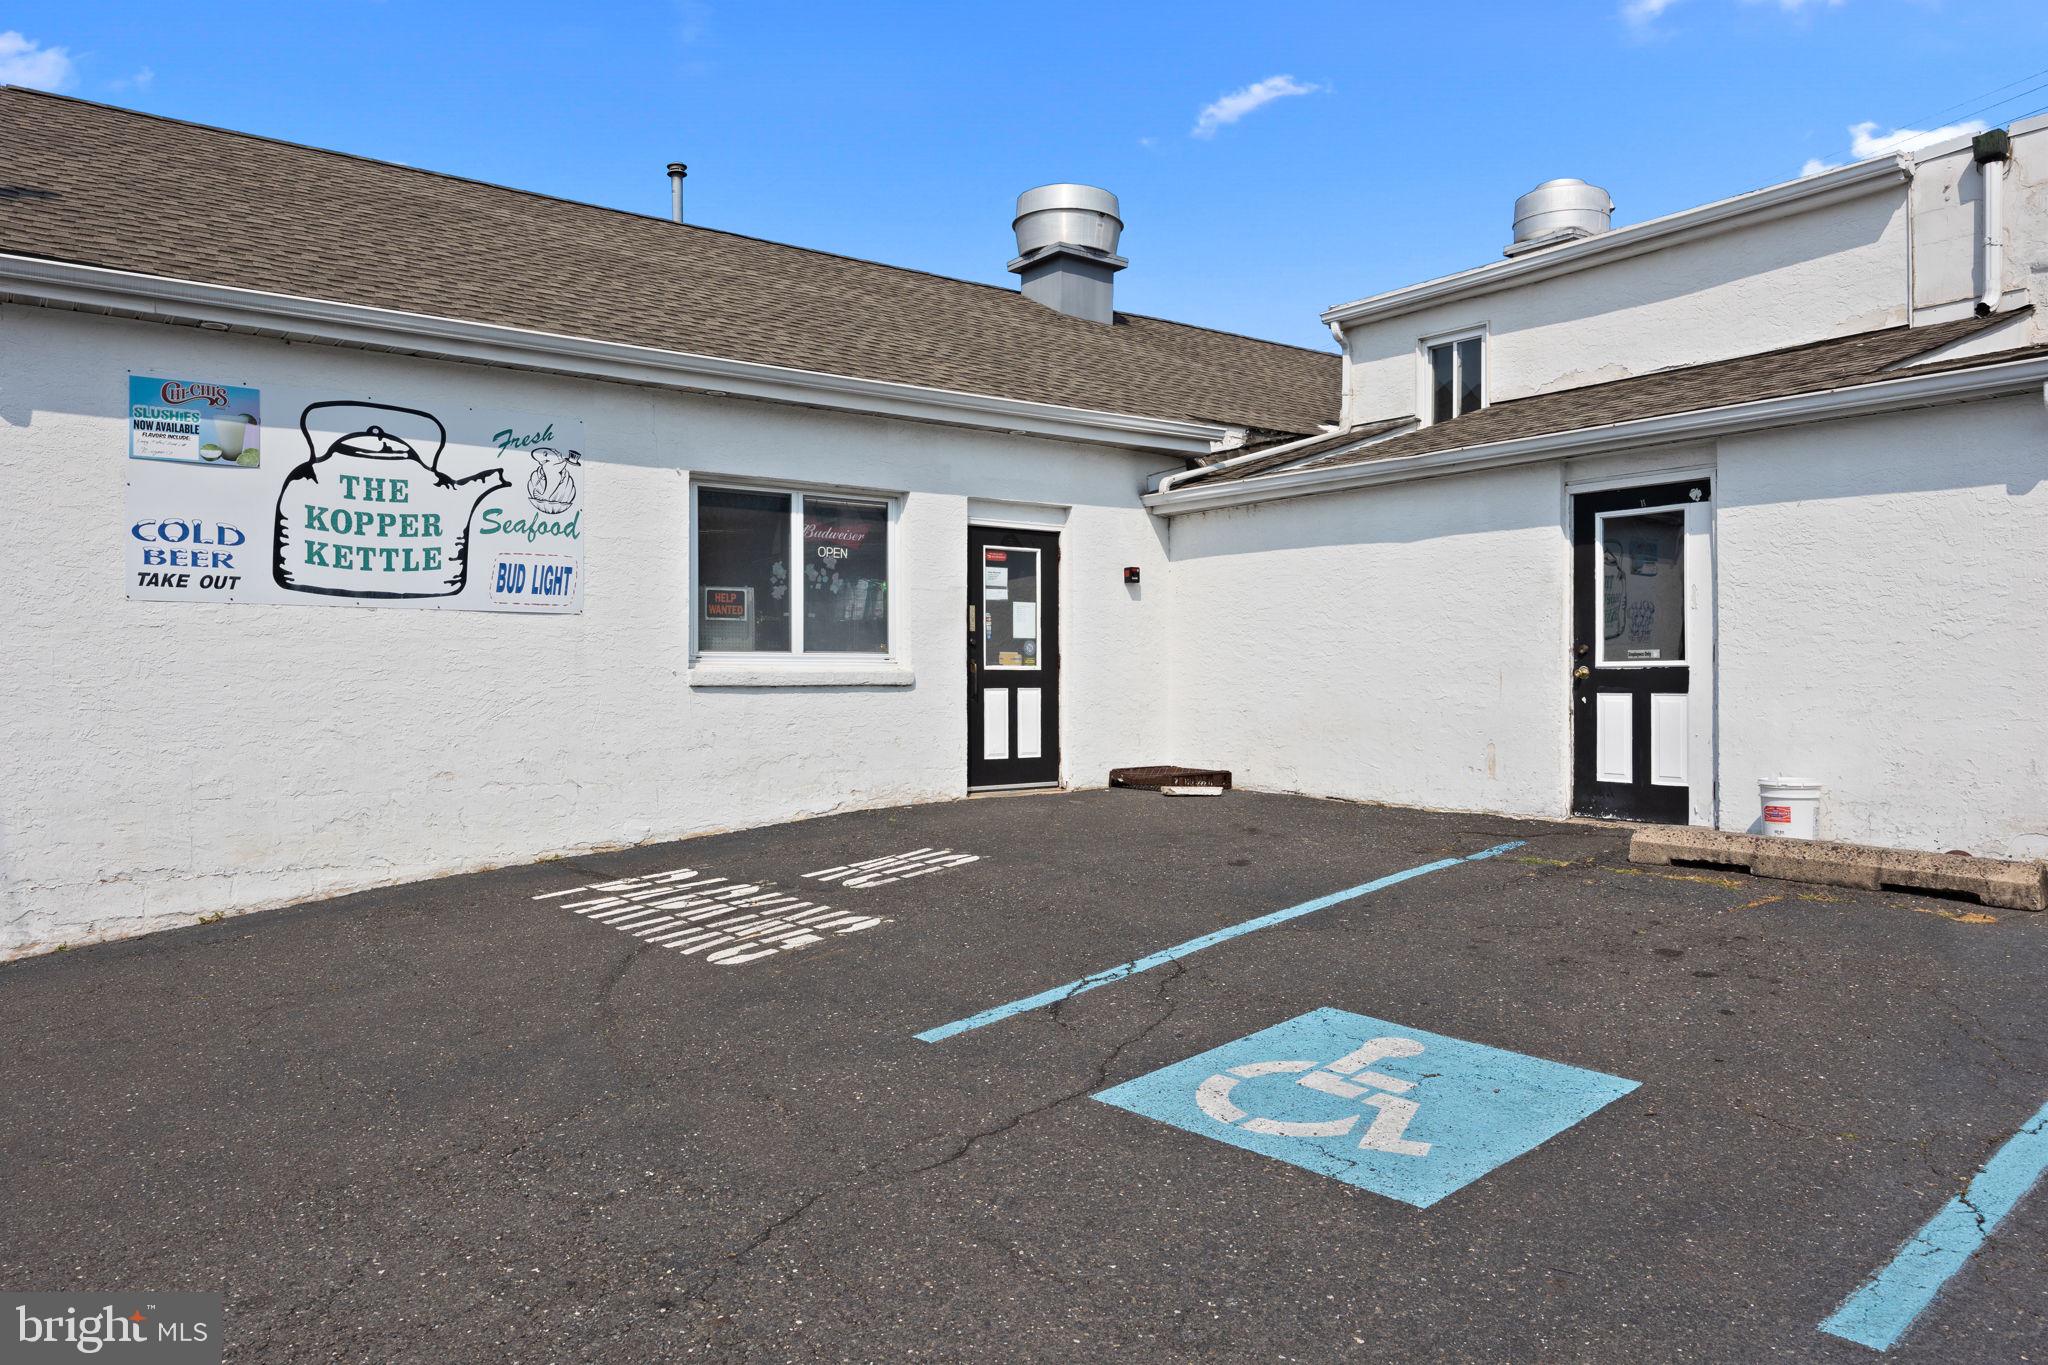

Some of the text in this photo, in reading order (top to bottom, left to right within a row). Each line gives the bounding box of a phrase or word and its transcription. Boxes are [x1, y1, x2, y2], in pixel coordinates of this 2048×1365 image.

[133, 406, 200, 423] SLUSHIES
[133, 419, 200, 435] NOW AVAILABLE
[492, 424, 555, 458] Fresh
[339, 474, 409, 503] THE
[131, 517, 246, 547] COLD
[304, 504, 443, 538] KOPPER
[480, 510, 581, 543] Seafood
[803, 523, 865, 541] Budweiser
[142, 546, 235, 569] BEER
[304, 540, 442, 572] KETTLE
[817, 546, 848, 559] OPEN
[137, 572, 242, 590] TAKE OUT
[496, 562, 573, 596] BUD LIGHT
[708, 604, 744, 615] WANTED
[715, 592, 737, 603] HELP
[800, 847, 981, 889] NO
[531, 867, 884, 966] PARKING
